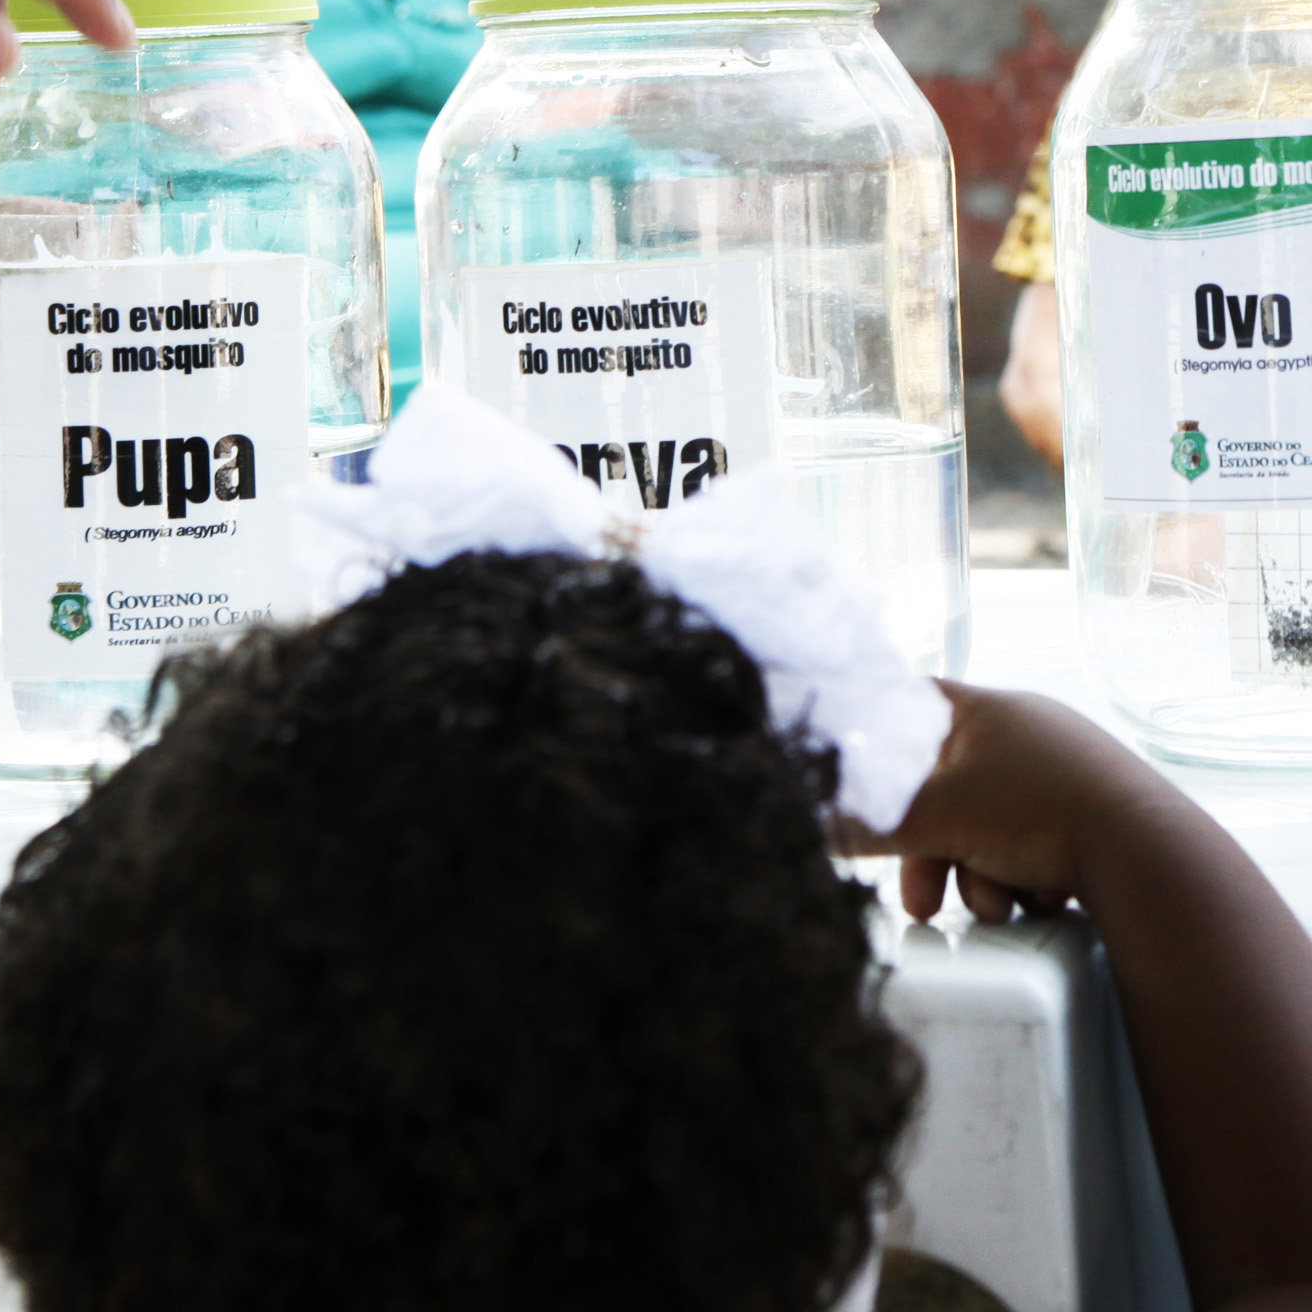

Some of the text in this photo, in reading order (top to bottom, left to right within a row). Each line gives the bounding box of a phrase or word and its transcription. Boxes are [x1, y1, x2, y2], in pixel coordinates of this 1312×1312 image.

[1108, 163, 1146, 193] Ciclo
[1150, 160, 1244, 191] evolutivo
[1249, 157, 1277, 188] do
[47, 297, 260, 335] Ciclo evolutivo
[502, 296, 708, 334] Ciclo evolutivo
[1194, 283, 1293, 350] Ovo
[67, 337, 245, 375] do mosquito
[518, 338, 692, 377] do mosquito
[1217, 438, 1301, 453] GOVERNO DO
[1218, 455, 1269, 468] ESTADO
[1272, 458, 1288, 467] DO
[62, 425, 257, 519] Pupa
[93, 524, 172, 543] Stegomyia
[176, 521, 229, 539] aegypti
[106, 590, 229, 610] GOVERNO DO
[108, 602, 274, 632] ESTADO DO CEARÁ
[107, 636, 161, 646] Secretaria
